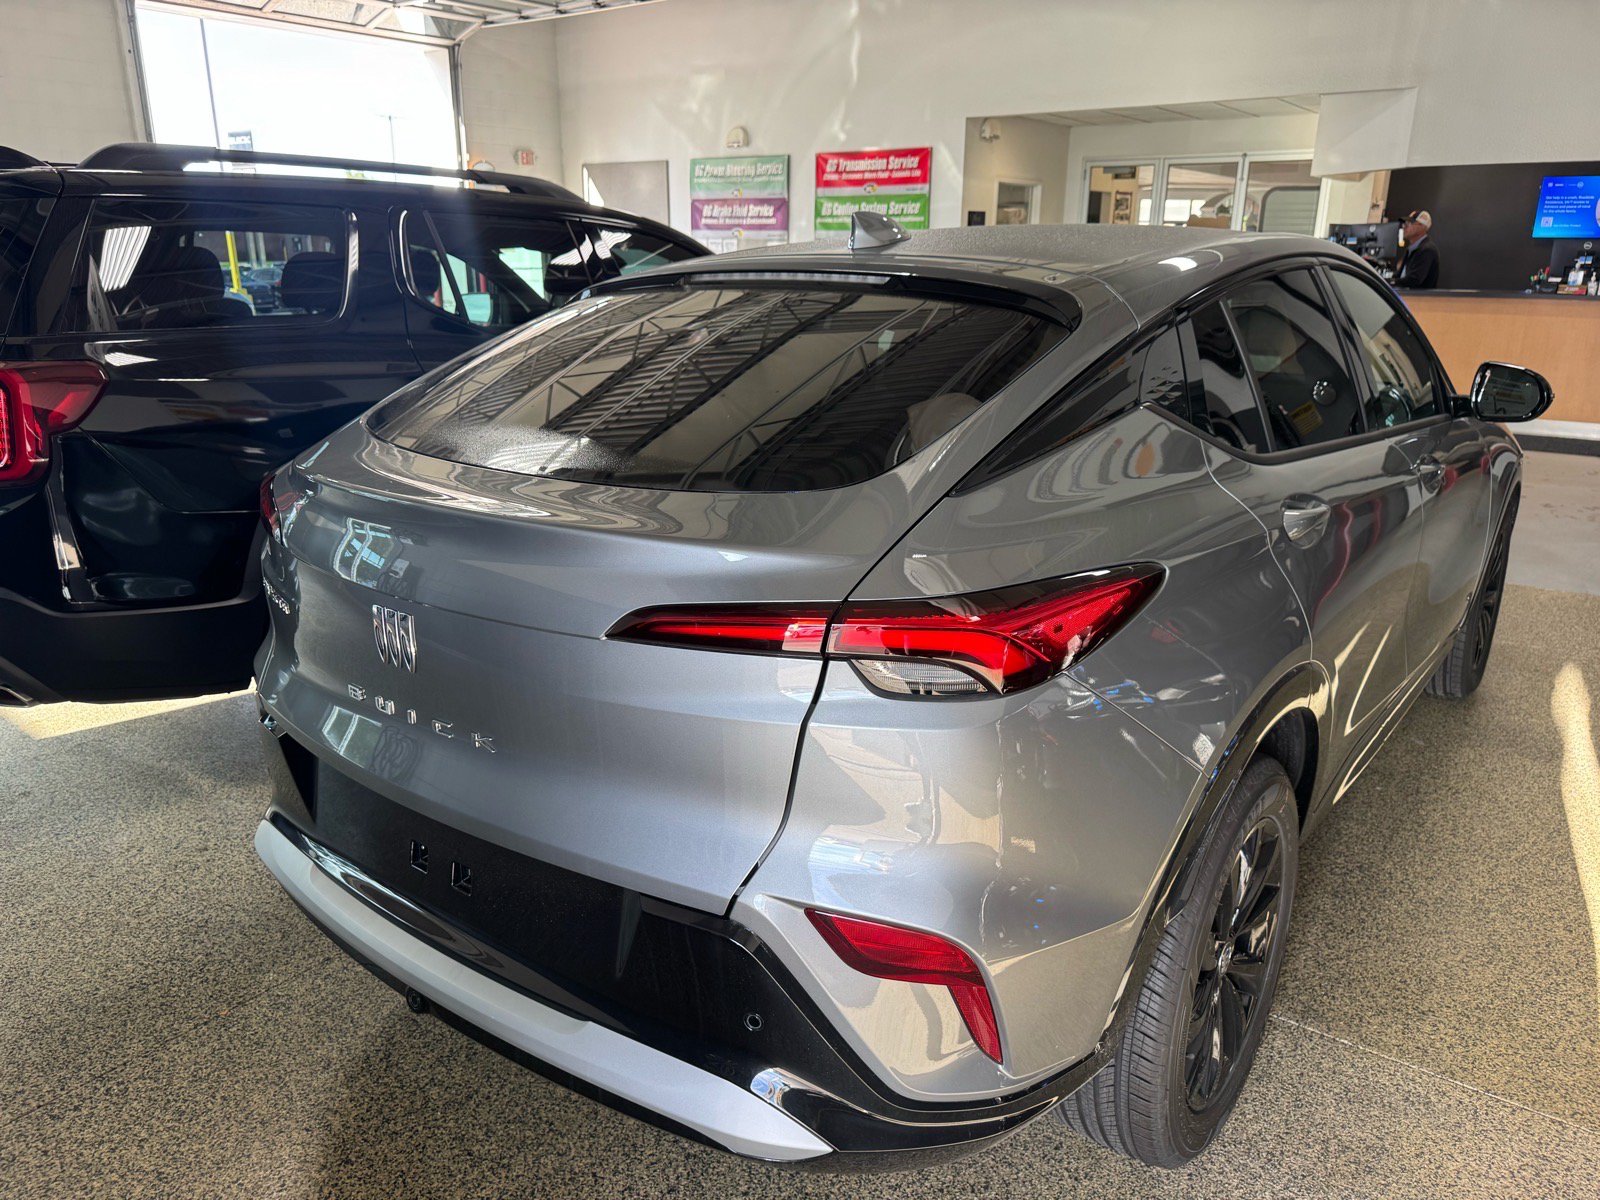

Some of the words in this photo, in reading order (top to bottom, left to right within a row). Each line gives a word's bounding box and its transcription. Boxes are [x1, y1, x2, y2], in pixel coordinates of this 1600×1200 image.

[757, 162, 783, 176] Service
[839, 157, 887, 171] Transmission
[889, 155, 919, 169] Service
[749, 204, 775, 216] Service
[889, 201, 920, 215] Service
[347, 682, 497, 753] BUICK
